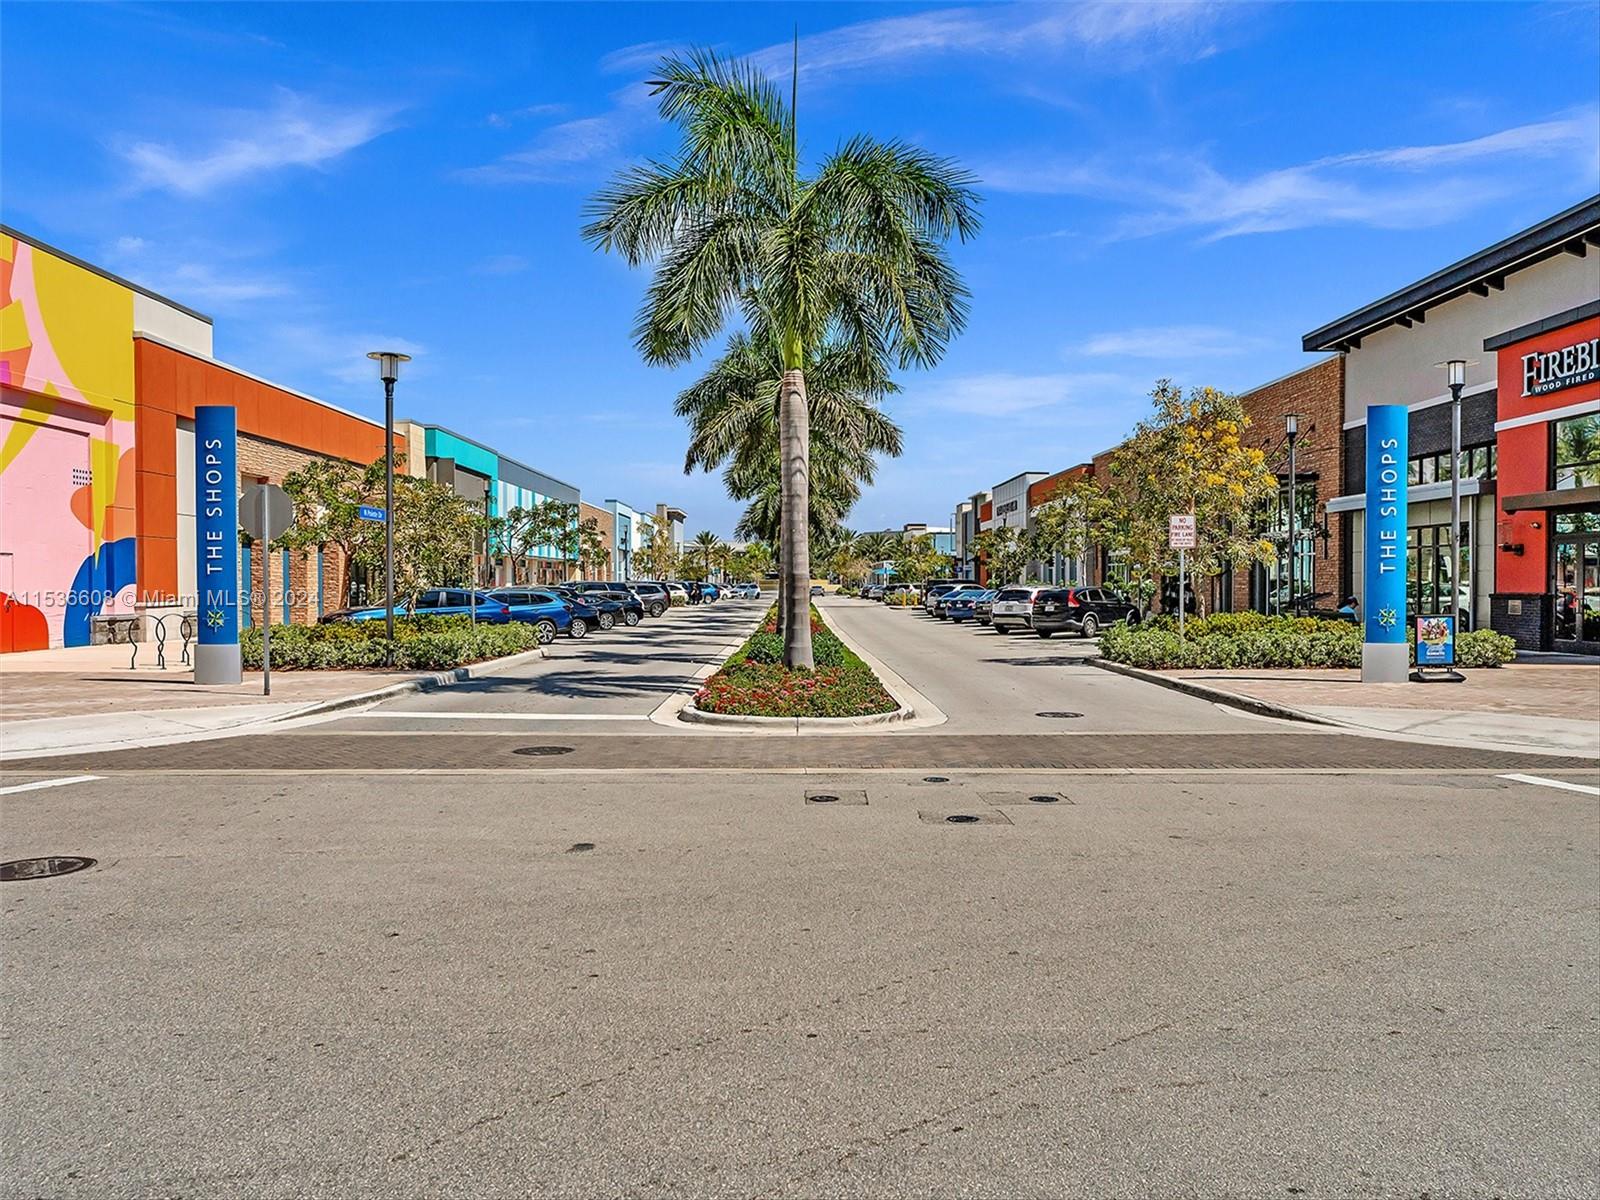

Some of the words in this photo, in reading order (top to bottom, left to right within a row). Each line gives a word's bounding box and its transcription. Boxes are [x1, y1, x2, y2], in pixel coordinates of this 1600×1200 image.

[1534, 381, 1561, 393] WOOD
[1566, 372, 1595, 385] FIRED
[205, 439, 223, 517] SHOPS
[1380, 438, 1398, 516] SHOPS
[206, 530, 223, 575] THE
[1380, 530, 1397, 574] THE
